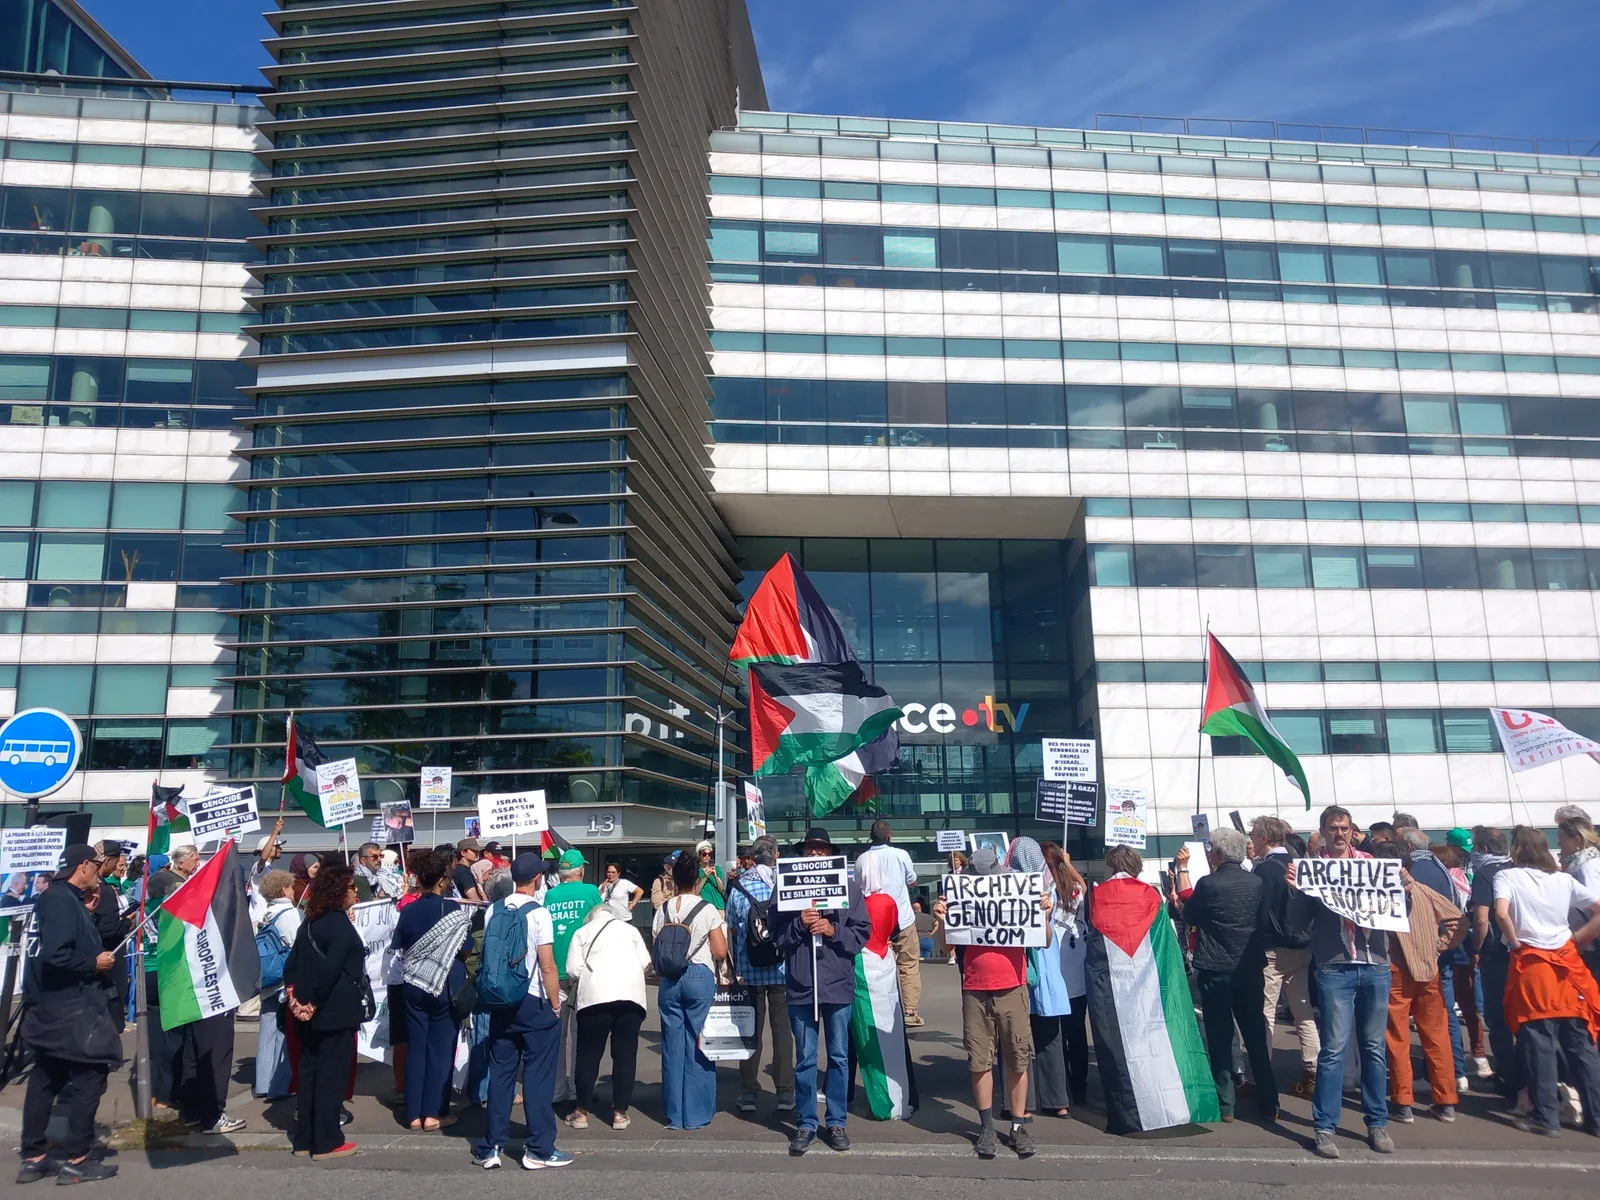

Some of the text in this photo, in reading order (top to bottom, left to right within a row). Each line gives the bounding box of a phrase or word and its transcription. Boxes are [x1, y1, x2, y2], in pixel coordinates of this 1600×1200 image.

[1511, 731, 1529, 740] UNION
[1078, 785, 1096, 793] GAZA
[202, 793, 241, 809] GÉNOCIDE
[497, 798, 528, 806] ISRAEL
[215, 808, 237, 817] GAZA
[196, 814, 254, 835] LE SILENCE TUE
[588, 814, 615, 832] 13
[792, 861, 833, 871] GÉNOCIDE
[796, 876, 827, 884] À GAZA
[1297, 860, 1399, 889] ARCHIVE
[782, 887, 843, 900] LE SILENCE TUE
[944, 874, 1041, 900] ARCHIVE
[552, 910, 580, 922] SRAEL
[945, 898, 1041, 928] GENOCIDE
[976, 928, 1026, 945] .COM
[197, 929, 225, 1012] EUROPALESTINE
